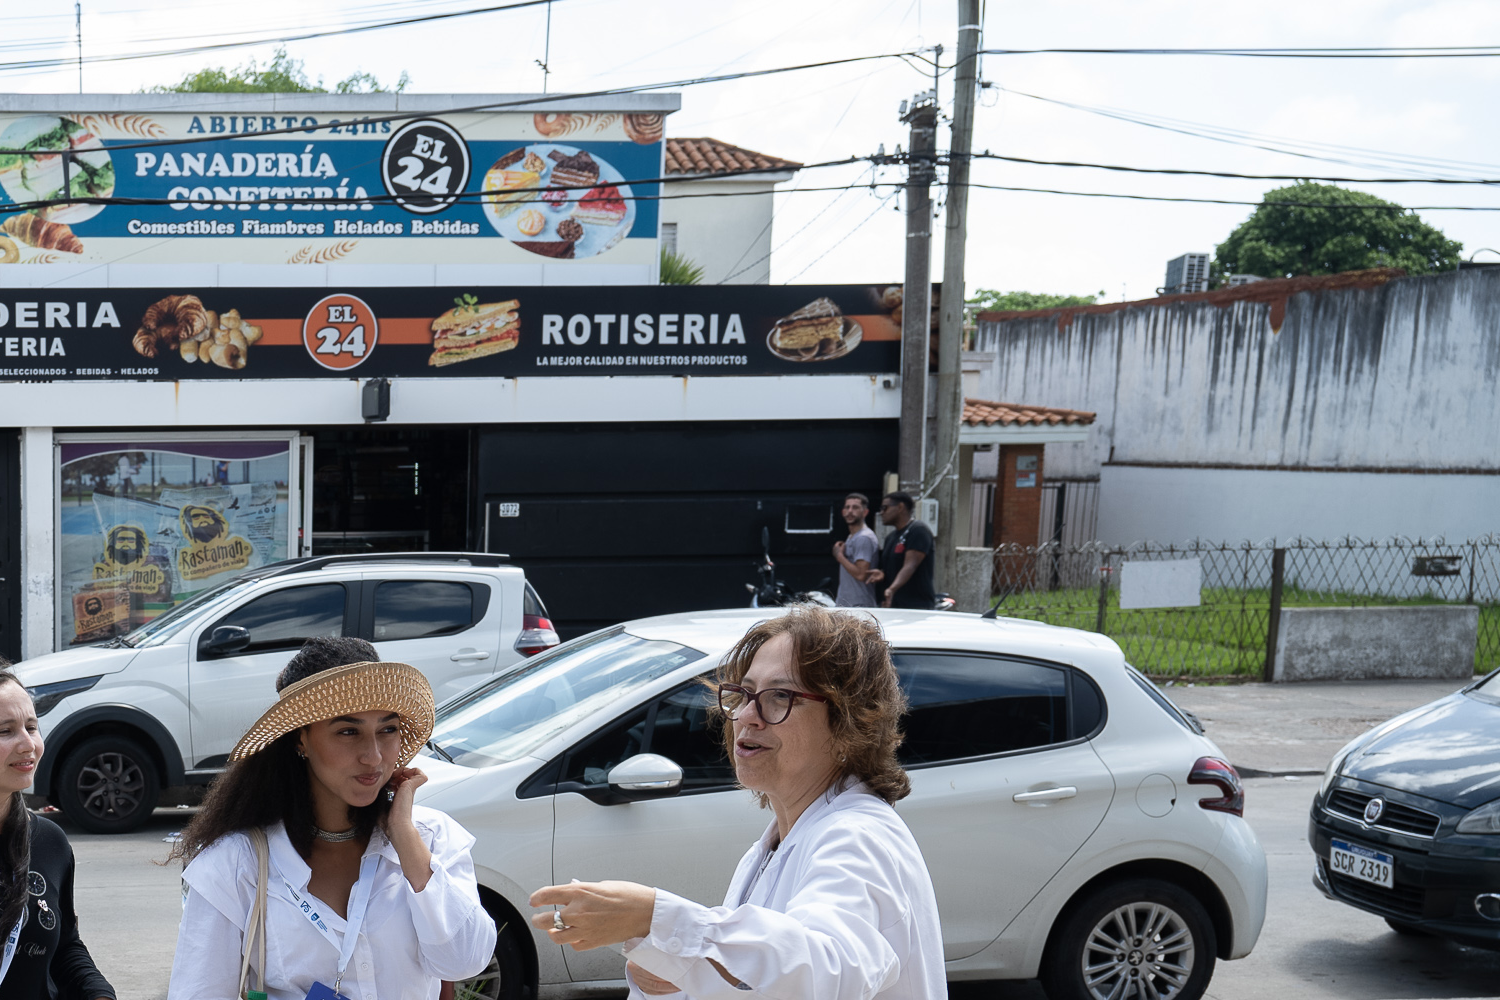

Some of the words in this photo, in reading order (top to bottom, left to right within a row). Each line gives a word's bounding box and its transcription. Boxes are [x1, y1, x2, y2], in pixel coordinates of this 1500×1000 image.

[187, 115, 318, 134] ABIERTO
[135, 144, 338, 177] PANADERÍA
[412, 134, 448, 164] EL
[392, 156, 452, 202] 24
[167, 178, 374, 211] CONFITERÍA
[127, 219, 235, 235] Comestibles
[242, 219, 325, 235] Fiambres
[333, 219, 403, 235] Helados
[411, 219, 480, 235] Bebidas
[328, 306, 357, 322] EL
[316, 325, 366, 357] 24
[542, 313, 746, 346] ROTISERIA
[76, 367, 112, 376] BEBIDAS
[121, 366, 159, 375] HELADOS
[536, 356, 549, 366] LA
[550, 356, 582, 366] MEJOR
[583, 356, 624, 366] CALIDAD
[625, 356, 638, 366] EN
[639, 355, 690, 365] NUESTROS
[691, 355, 748, 365] PRODUCTOS
[181, 540, 243, 570] Rastaman
[1334, 850, 1355, 873] SCR
[1360, 858, 1389, 883] 2319
